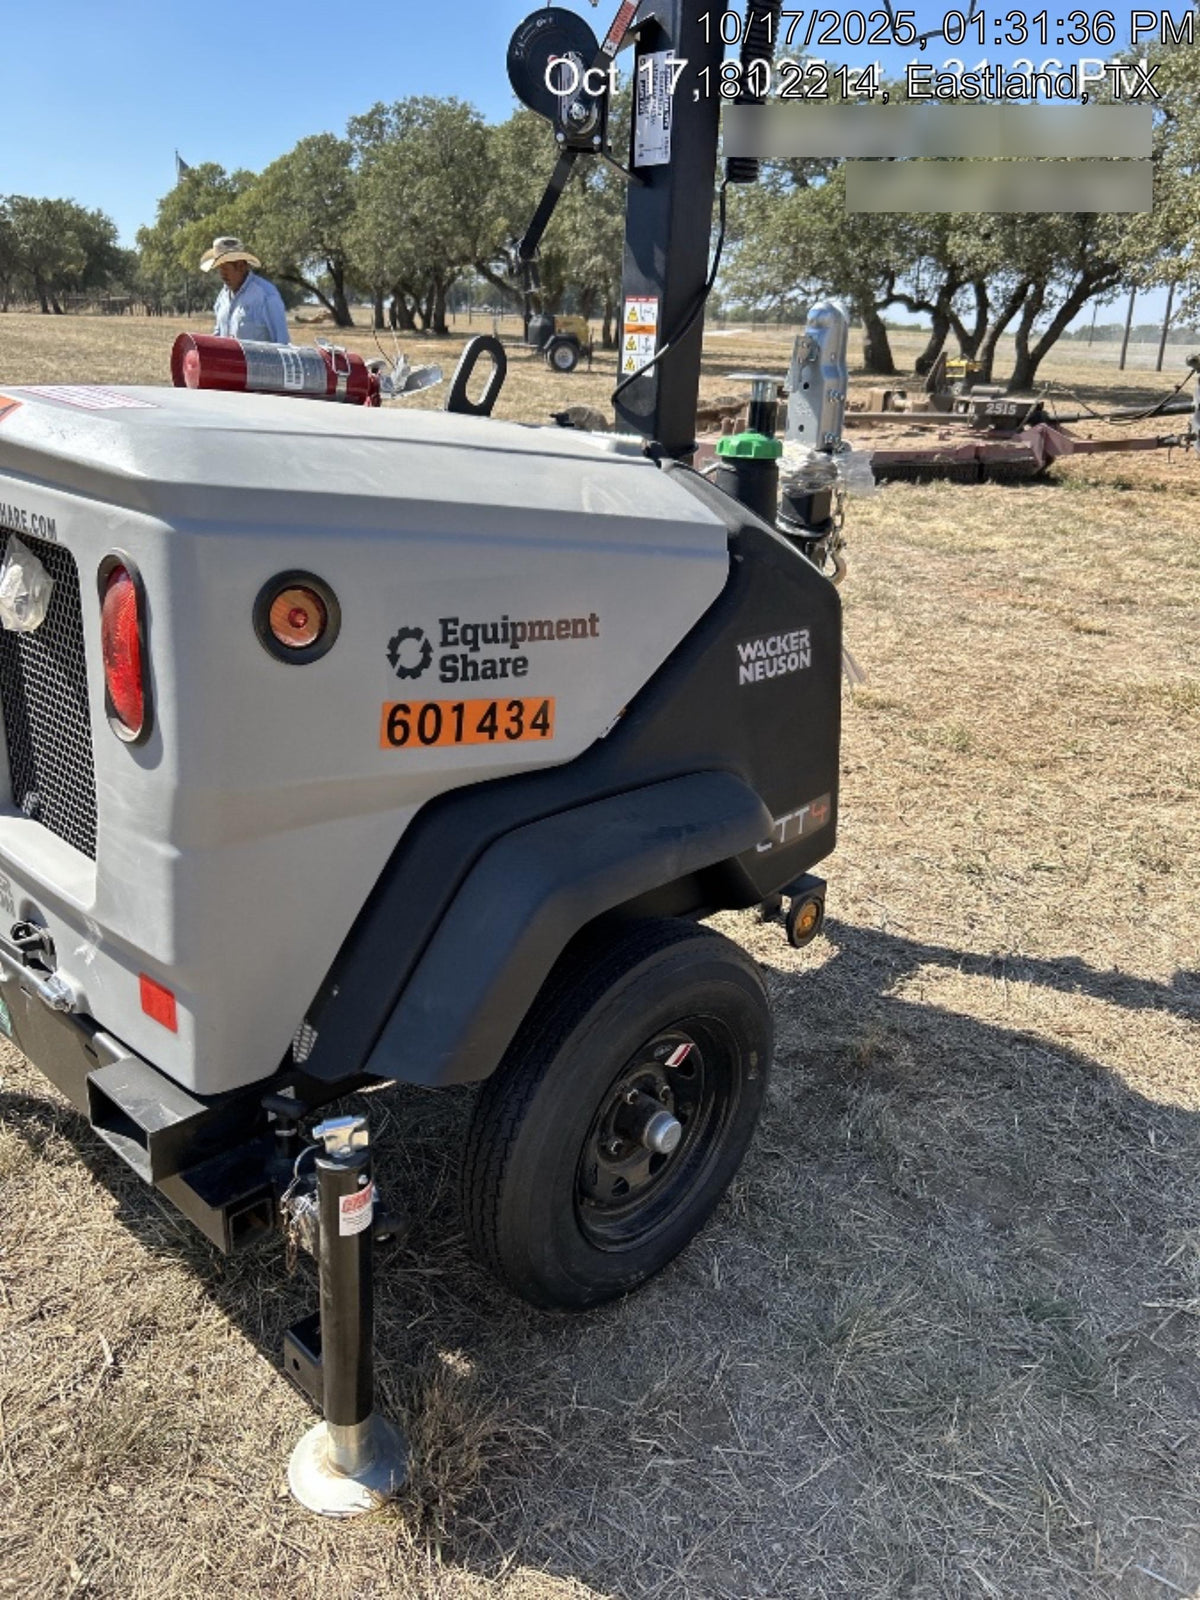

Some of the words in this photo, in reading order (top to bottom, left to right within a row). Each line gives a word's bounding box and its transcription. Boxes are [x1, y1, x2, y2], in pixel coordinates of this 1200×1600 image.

[438, 613, 600, 652] Equipment
[737, 628, 811, 662] WACKER
[438, 653, 528, 684] Share
[739, 648, 812, 686] NEUSON
[386, 699, 551, 747] 601434
